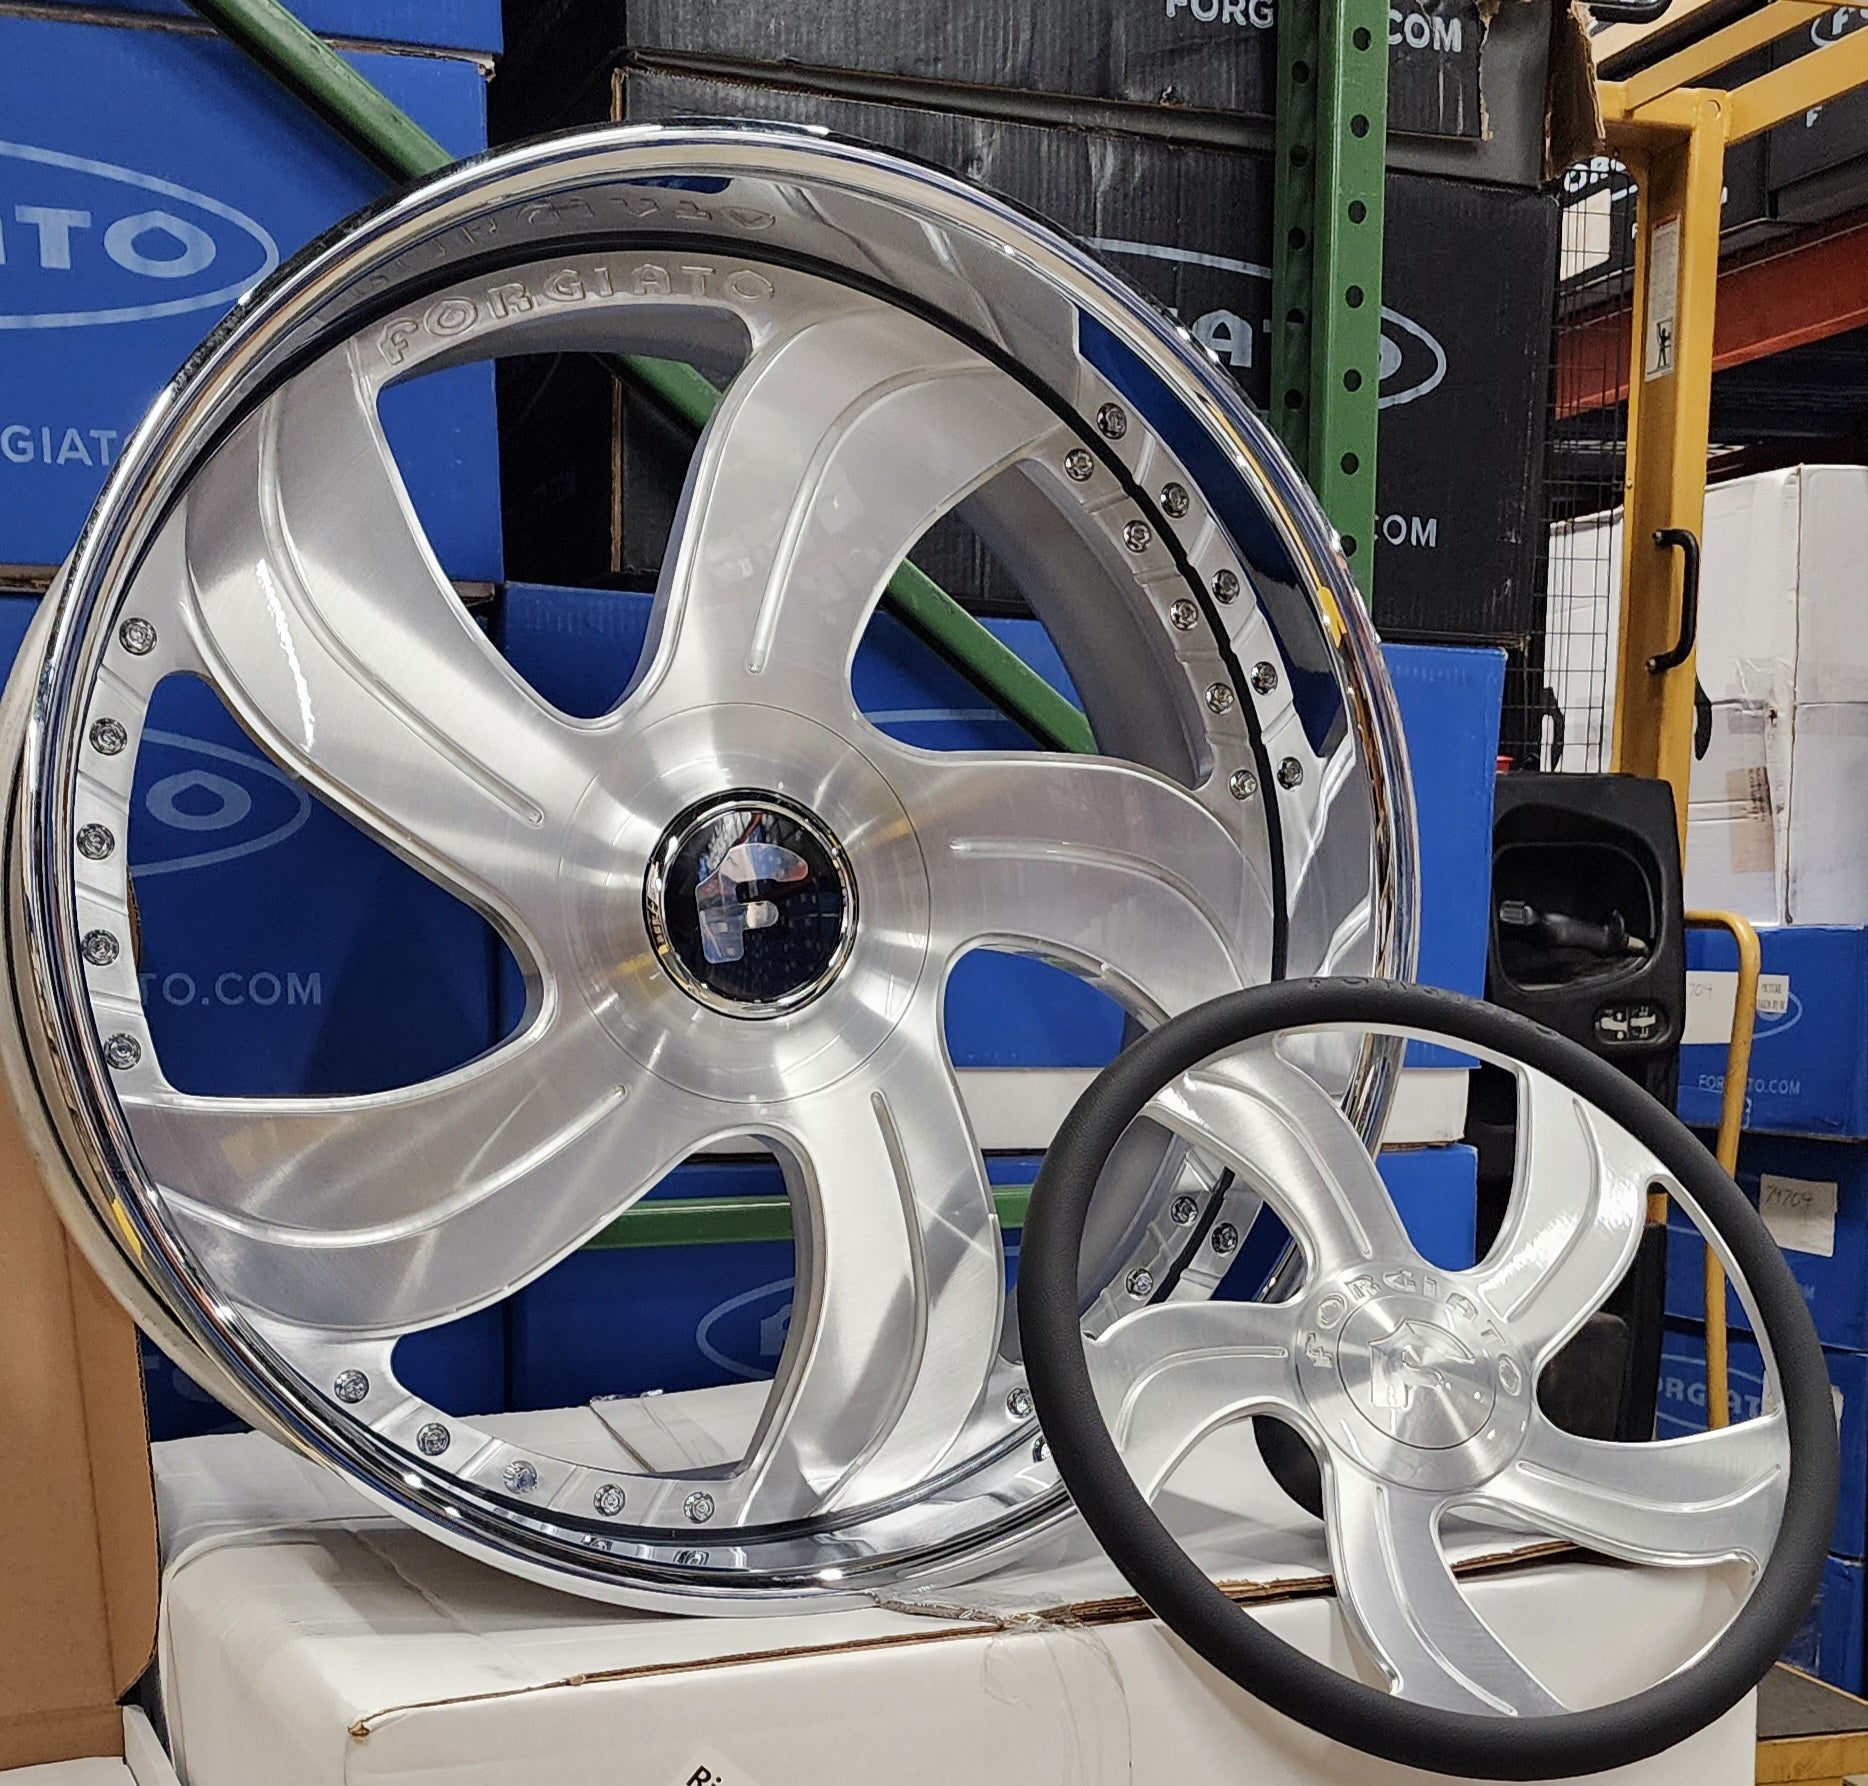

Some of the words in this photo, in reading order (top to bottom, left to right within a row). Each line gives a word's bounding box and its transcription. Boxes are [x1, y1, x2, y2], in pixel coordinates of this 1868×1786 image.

[0, 205, 217, 278] TO
[376, 263, 776, 366] FORGIATO
[0, 424, 133, 467] GIAT
[1374, 514, 1438, 547] OM
